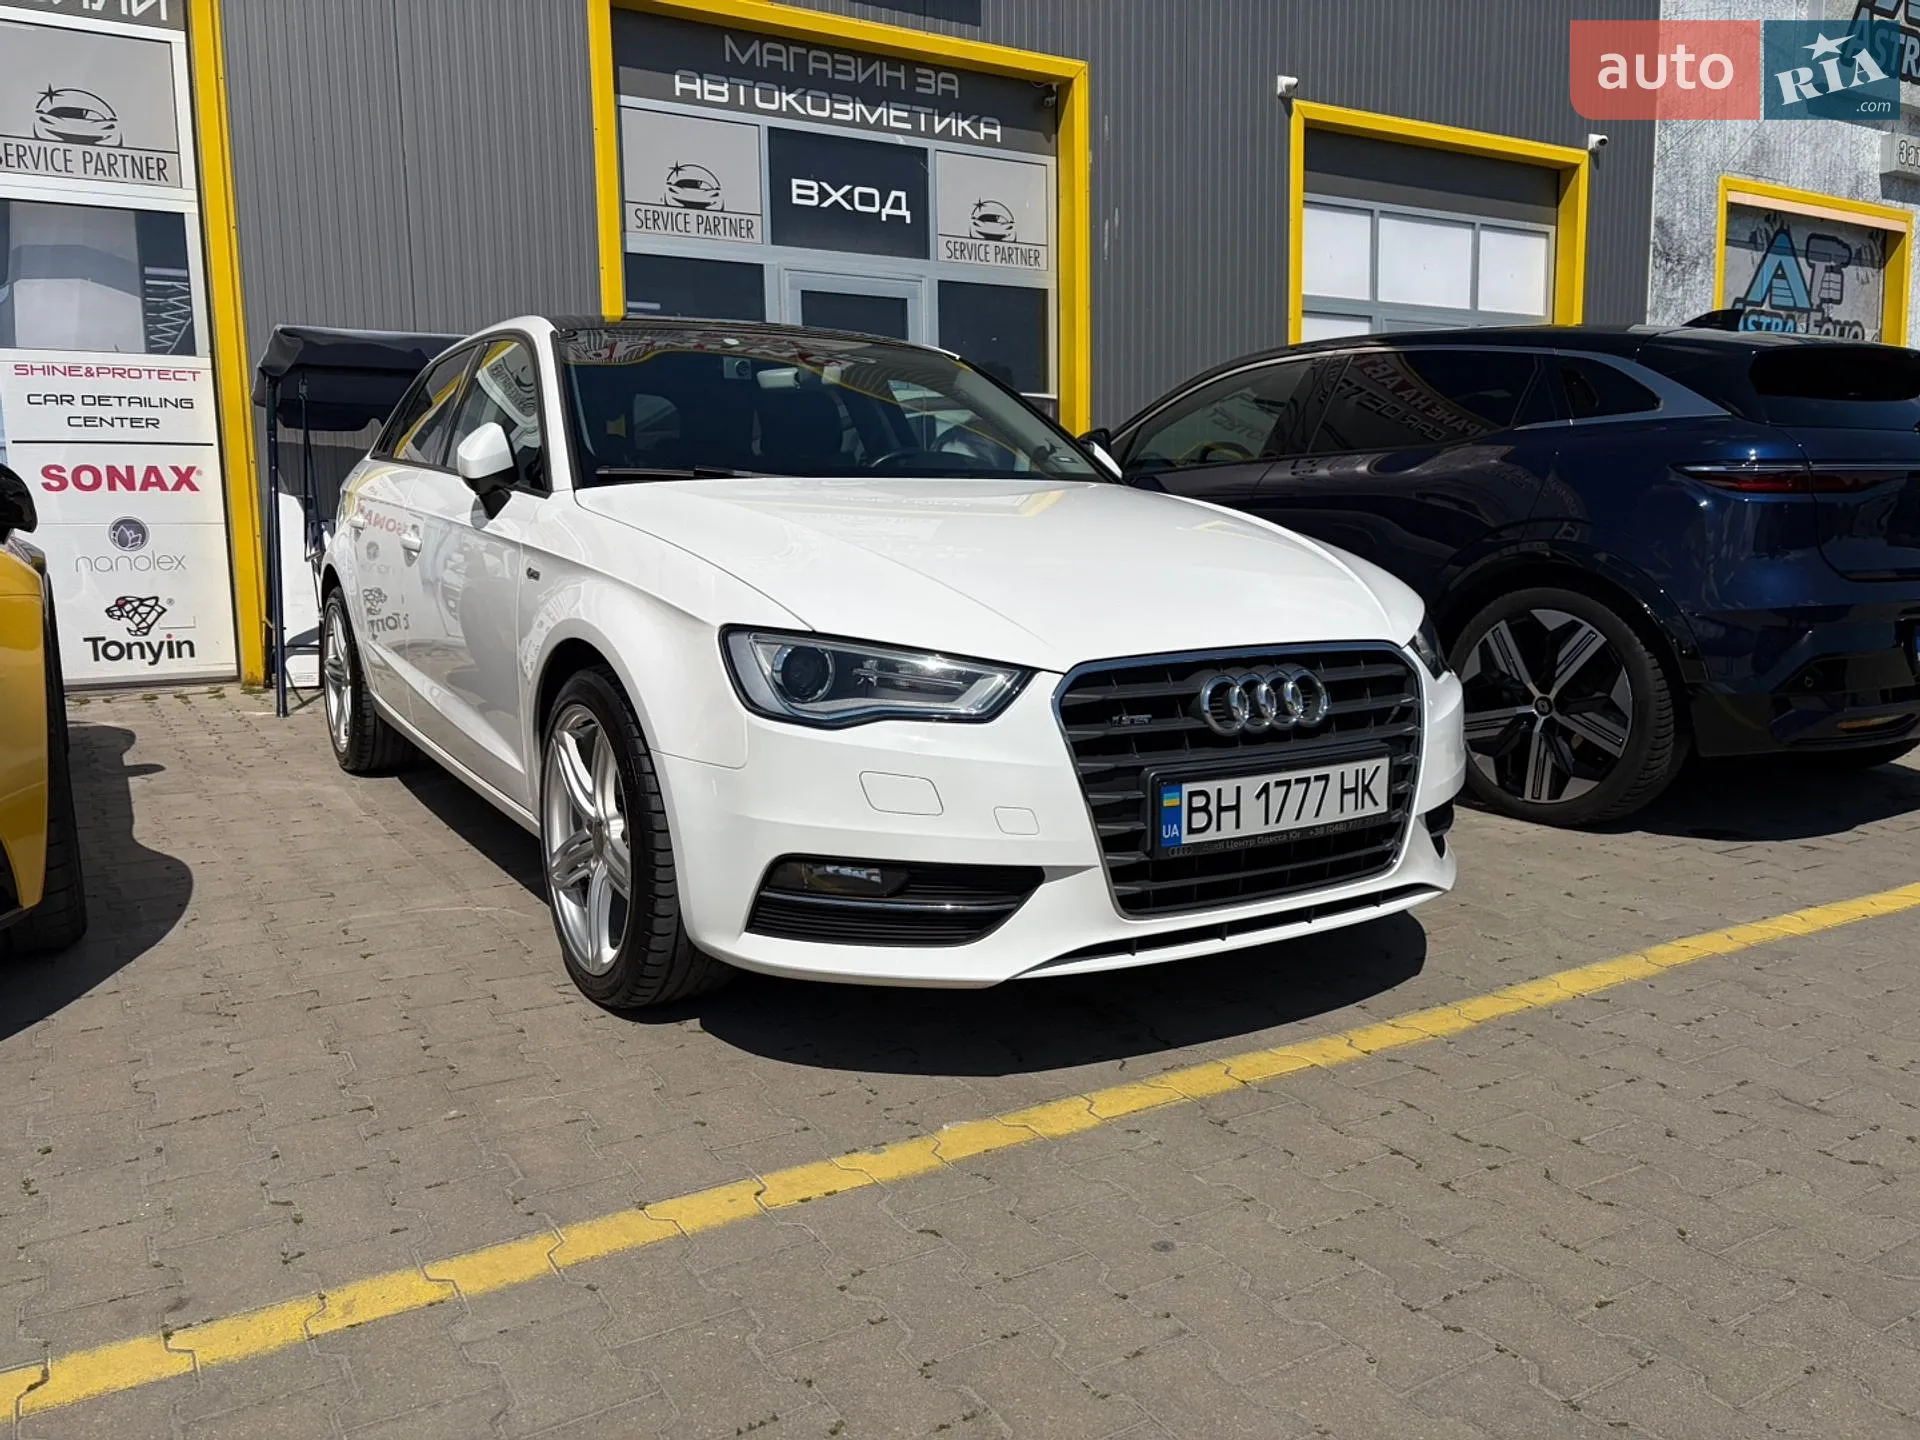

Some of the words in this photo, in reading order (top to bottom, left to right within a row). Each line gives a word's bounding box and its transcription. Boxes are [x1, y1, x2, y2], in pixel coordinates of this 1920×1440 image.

[724, 34, 905, 91] МАГАЗИН
[915, 68, 960, 99] ЗА
[674, 69, 1002, 143] АВТОКОЗМЕТИКА
[0, 142, 74, 174] ERVICE
[82, 151, 169, 183] PARTNER
[790, 178, 911, 224] ВХОД
[634, 208, 691, 233] SERVICE
[696, 216, 755, 240] PARTNER
[945, 239, 991, 263] SERVICE
[994, 244, 1042, 267] PARTNER
[14, 363, 201, 382] SHINE&PROTECT
[26, 393, 74, 408] CAR
[81, 394, 195, 410] DETAILING
[67, 415, 161, 430] CENTER
[41, 464, 200, 493] SONAX
[75, 551, 187, 574] nanolex
[83, 633, 196, 666] Tonyin
[1186, 785, 1241, 835] BH
[1254, 773, 1330, 826] 1777
[1339, 765, 1380, 814] HK
[1163, 824, 1180, 839] UA
